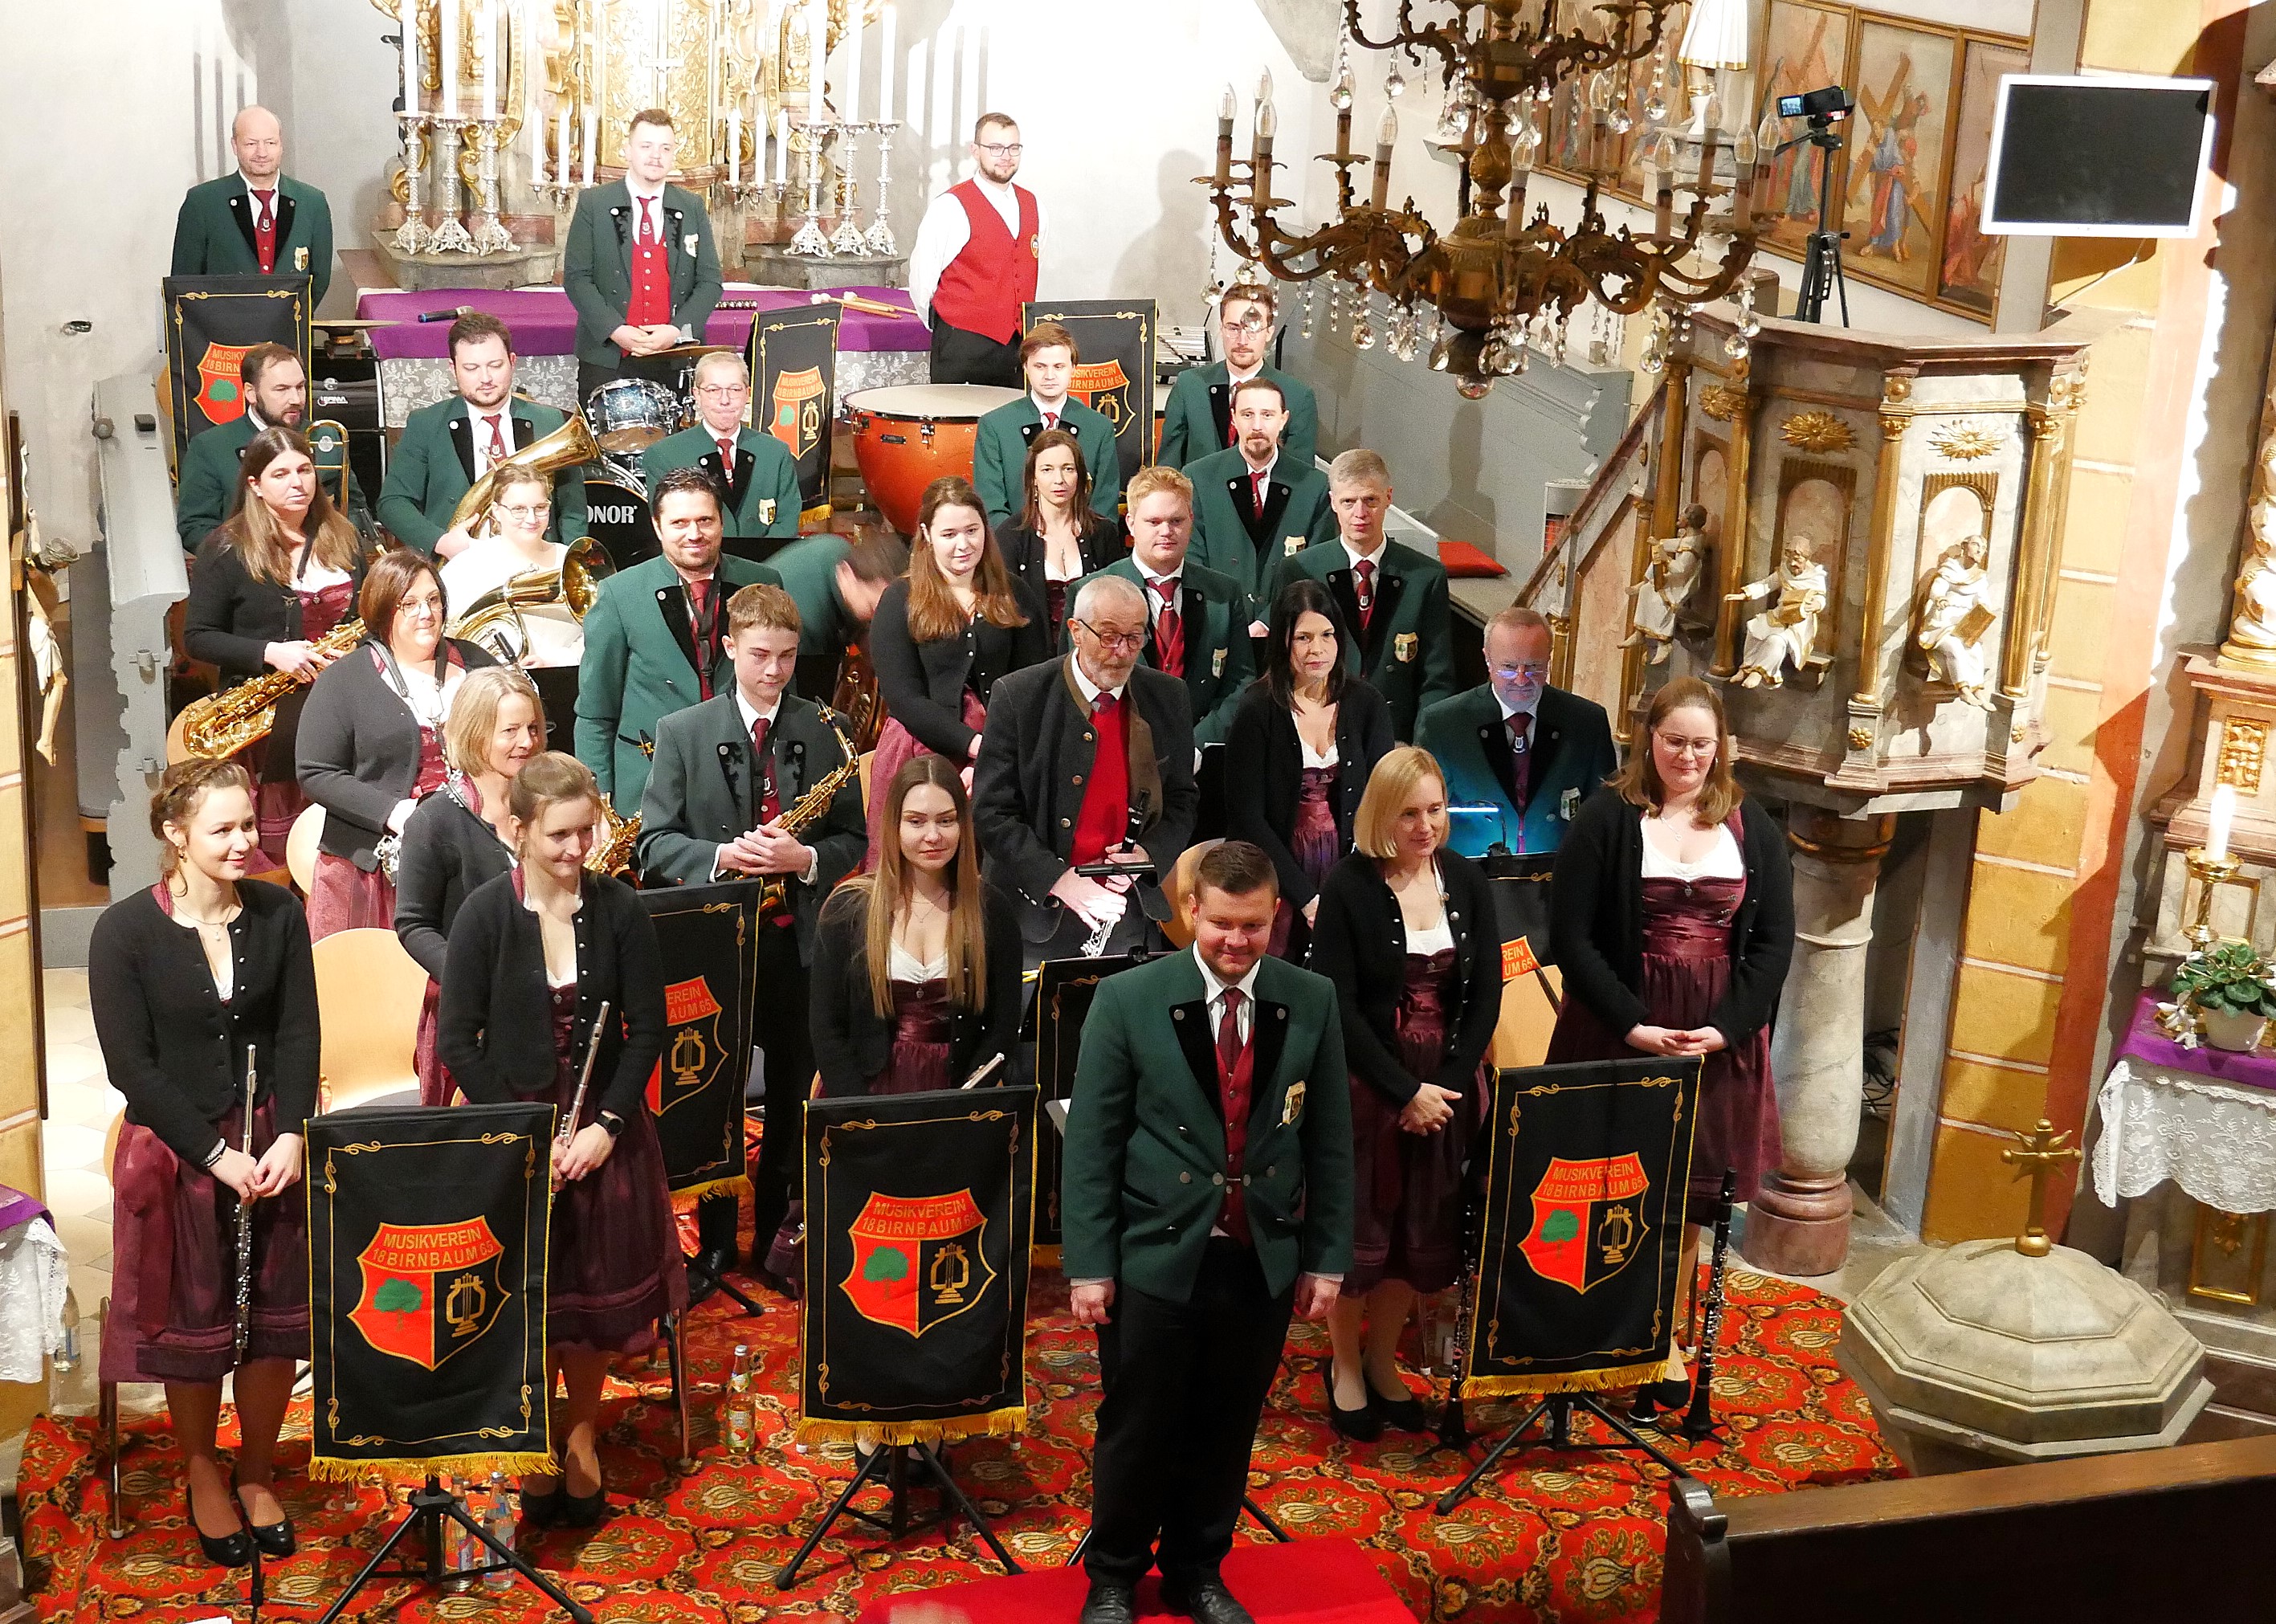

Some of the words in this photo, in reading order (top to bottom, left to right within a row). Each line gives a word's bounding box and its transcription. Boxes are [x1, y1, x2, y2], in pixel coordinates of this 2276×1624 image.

[1114, 375, 1123, 385] 65
[1521, 957, 1533, 970] 65
[699, 998, 712, 1012] 65
[1552, 1162, 1634, 1181] MUSIKVEREIN
[1631, 1176, 1643, 1190] 65
[872, 1198, 967, 1218] MUSIKVEREIN
[876, 1218, 963, 1235] BIRNBAUM
[383, 1226, 482, 1250] MUSIKVEREIN
[373, 1247, 385, 1263] 18
[387, 1248, 478, 1267] BIRNBAUM
[479, 1239, 494, 1256] 65
